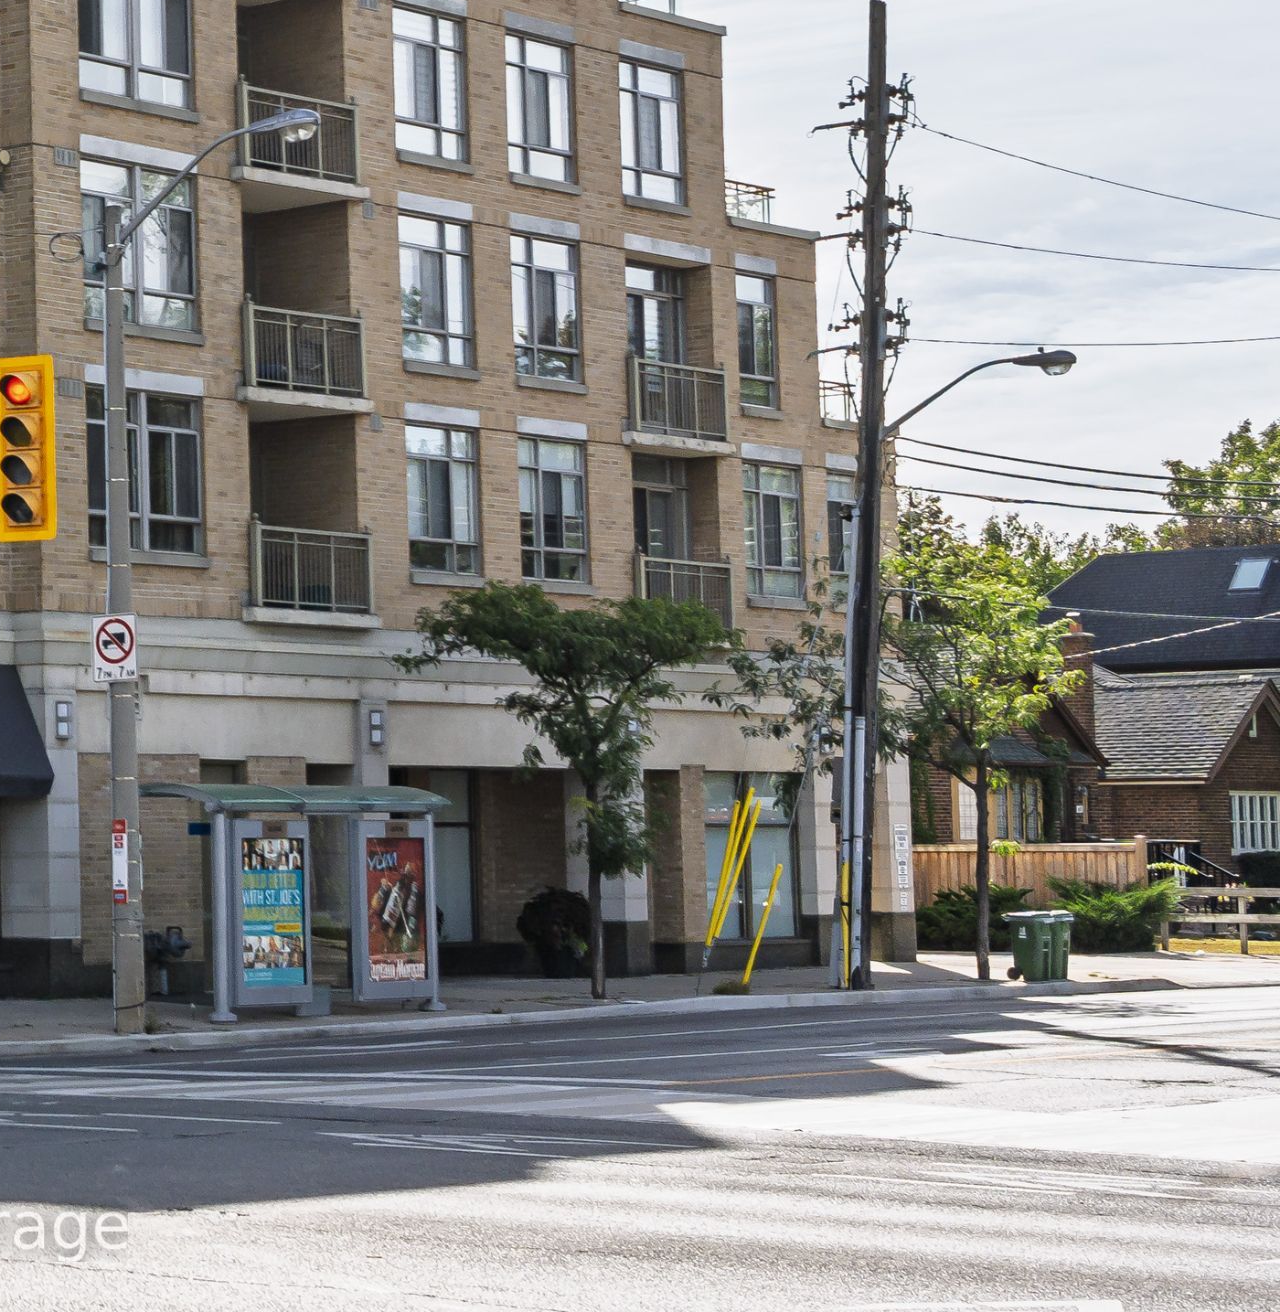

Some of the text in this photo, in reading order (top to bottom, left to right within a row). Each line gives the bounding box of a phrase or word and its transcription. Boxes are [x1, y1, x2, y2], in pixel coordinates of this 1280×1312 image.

[96, 667, 107, 679] 7
[119, 665, 125, 678] 7
[242, 889, 265, 905] WITH
